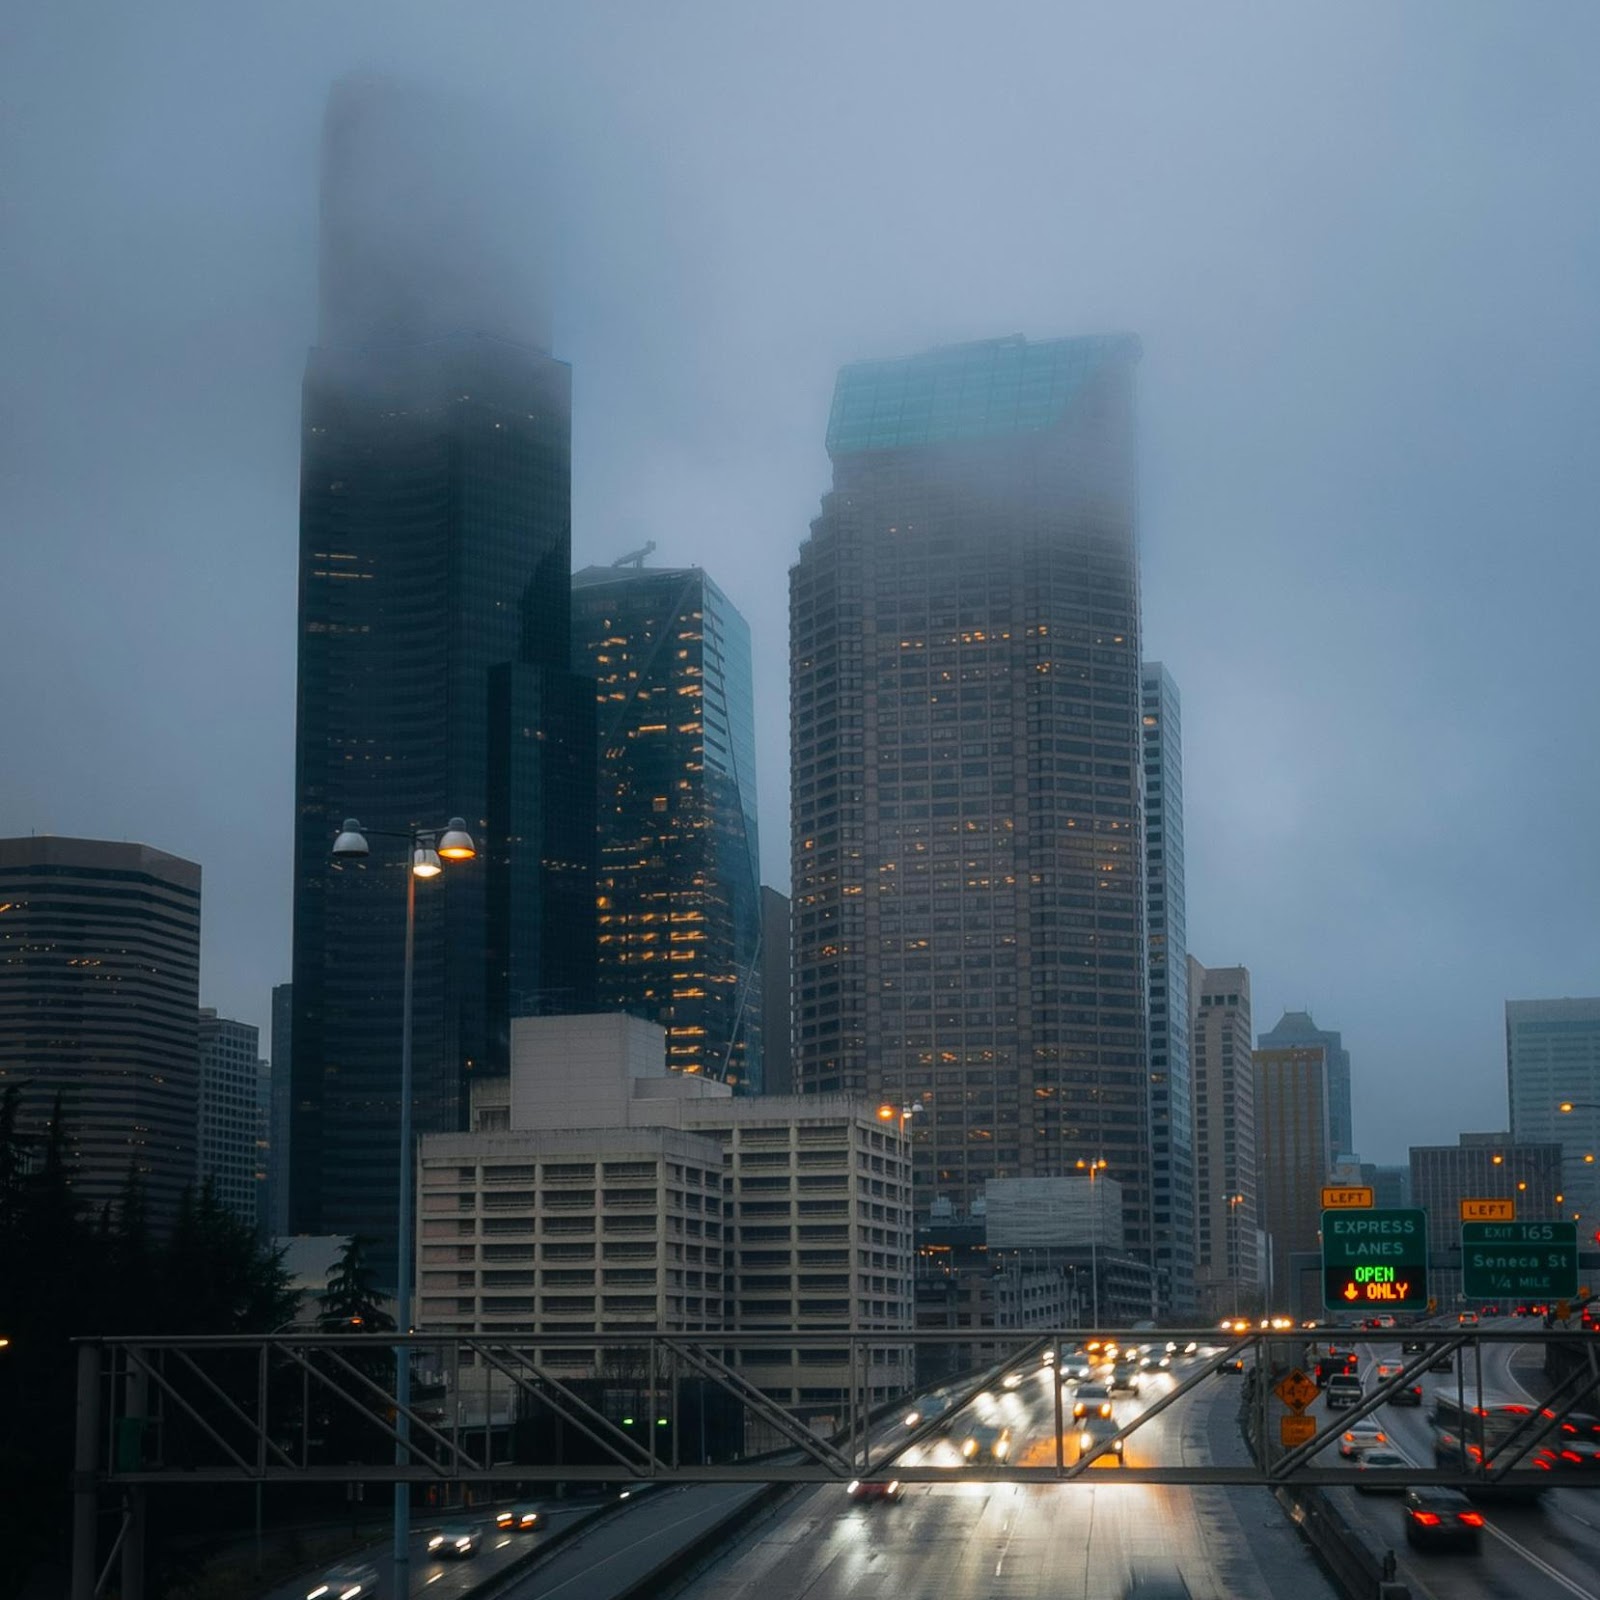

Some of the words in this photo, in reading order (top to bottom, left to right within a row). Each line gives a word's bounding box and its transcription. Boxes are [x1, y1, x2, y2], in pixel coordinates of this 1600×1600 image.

[1330, 1193, 1364, 1203] LEFT
[1469, 1205, 1505, 1216] LEFT
[1334, 1220, 1415, 1234] EXPRESS
[1484, 1226, 1513, 1238] EXIT
[1521, 1225, 1553, 1240] 165
[1345, 1242, 1404, 1255] LANES
[1473, 1254, 1539, 1268] Seneca
[1548, 1254, 1567, 1268] St
[1355, 1266, 1394, 1282] OPEN
[1519, 1277, 1551, 1288] MILE
[1366, 1283, 1408, 1299] ONLY
